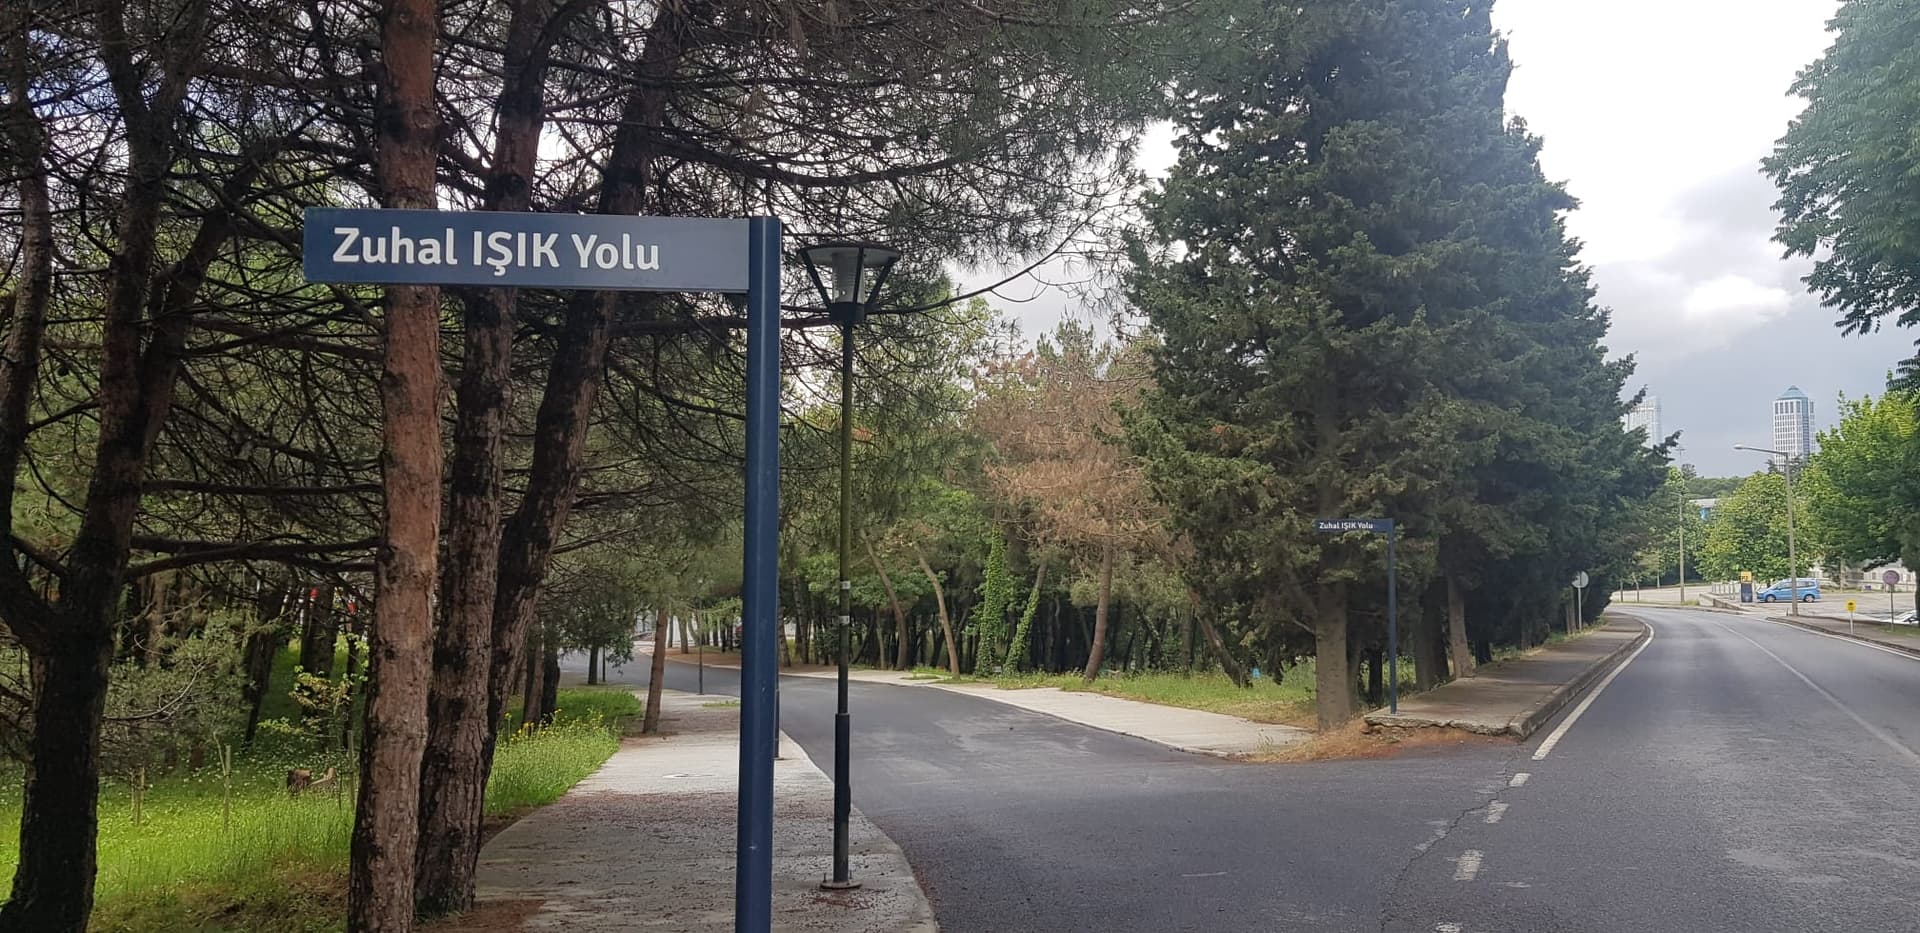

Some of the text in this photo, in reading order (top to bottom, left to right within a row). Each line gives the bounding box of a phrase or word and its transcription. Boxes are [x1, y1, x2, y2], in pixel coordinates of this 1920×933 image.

[332, 226, 660, 276] Zuhal IŞIK Yolu
[1319, 521, 1374, 530] Zuhal IŞIK Yolu
